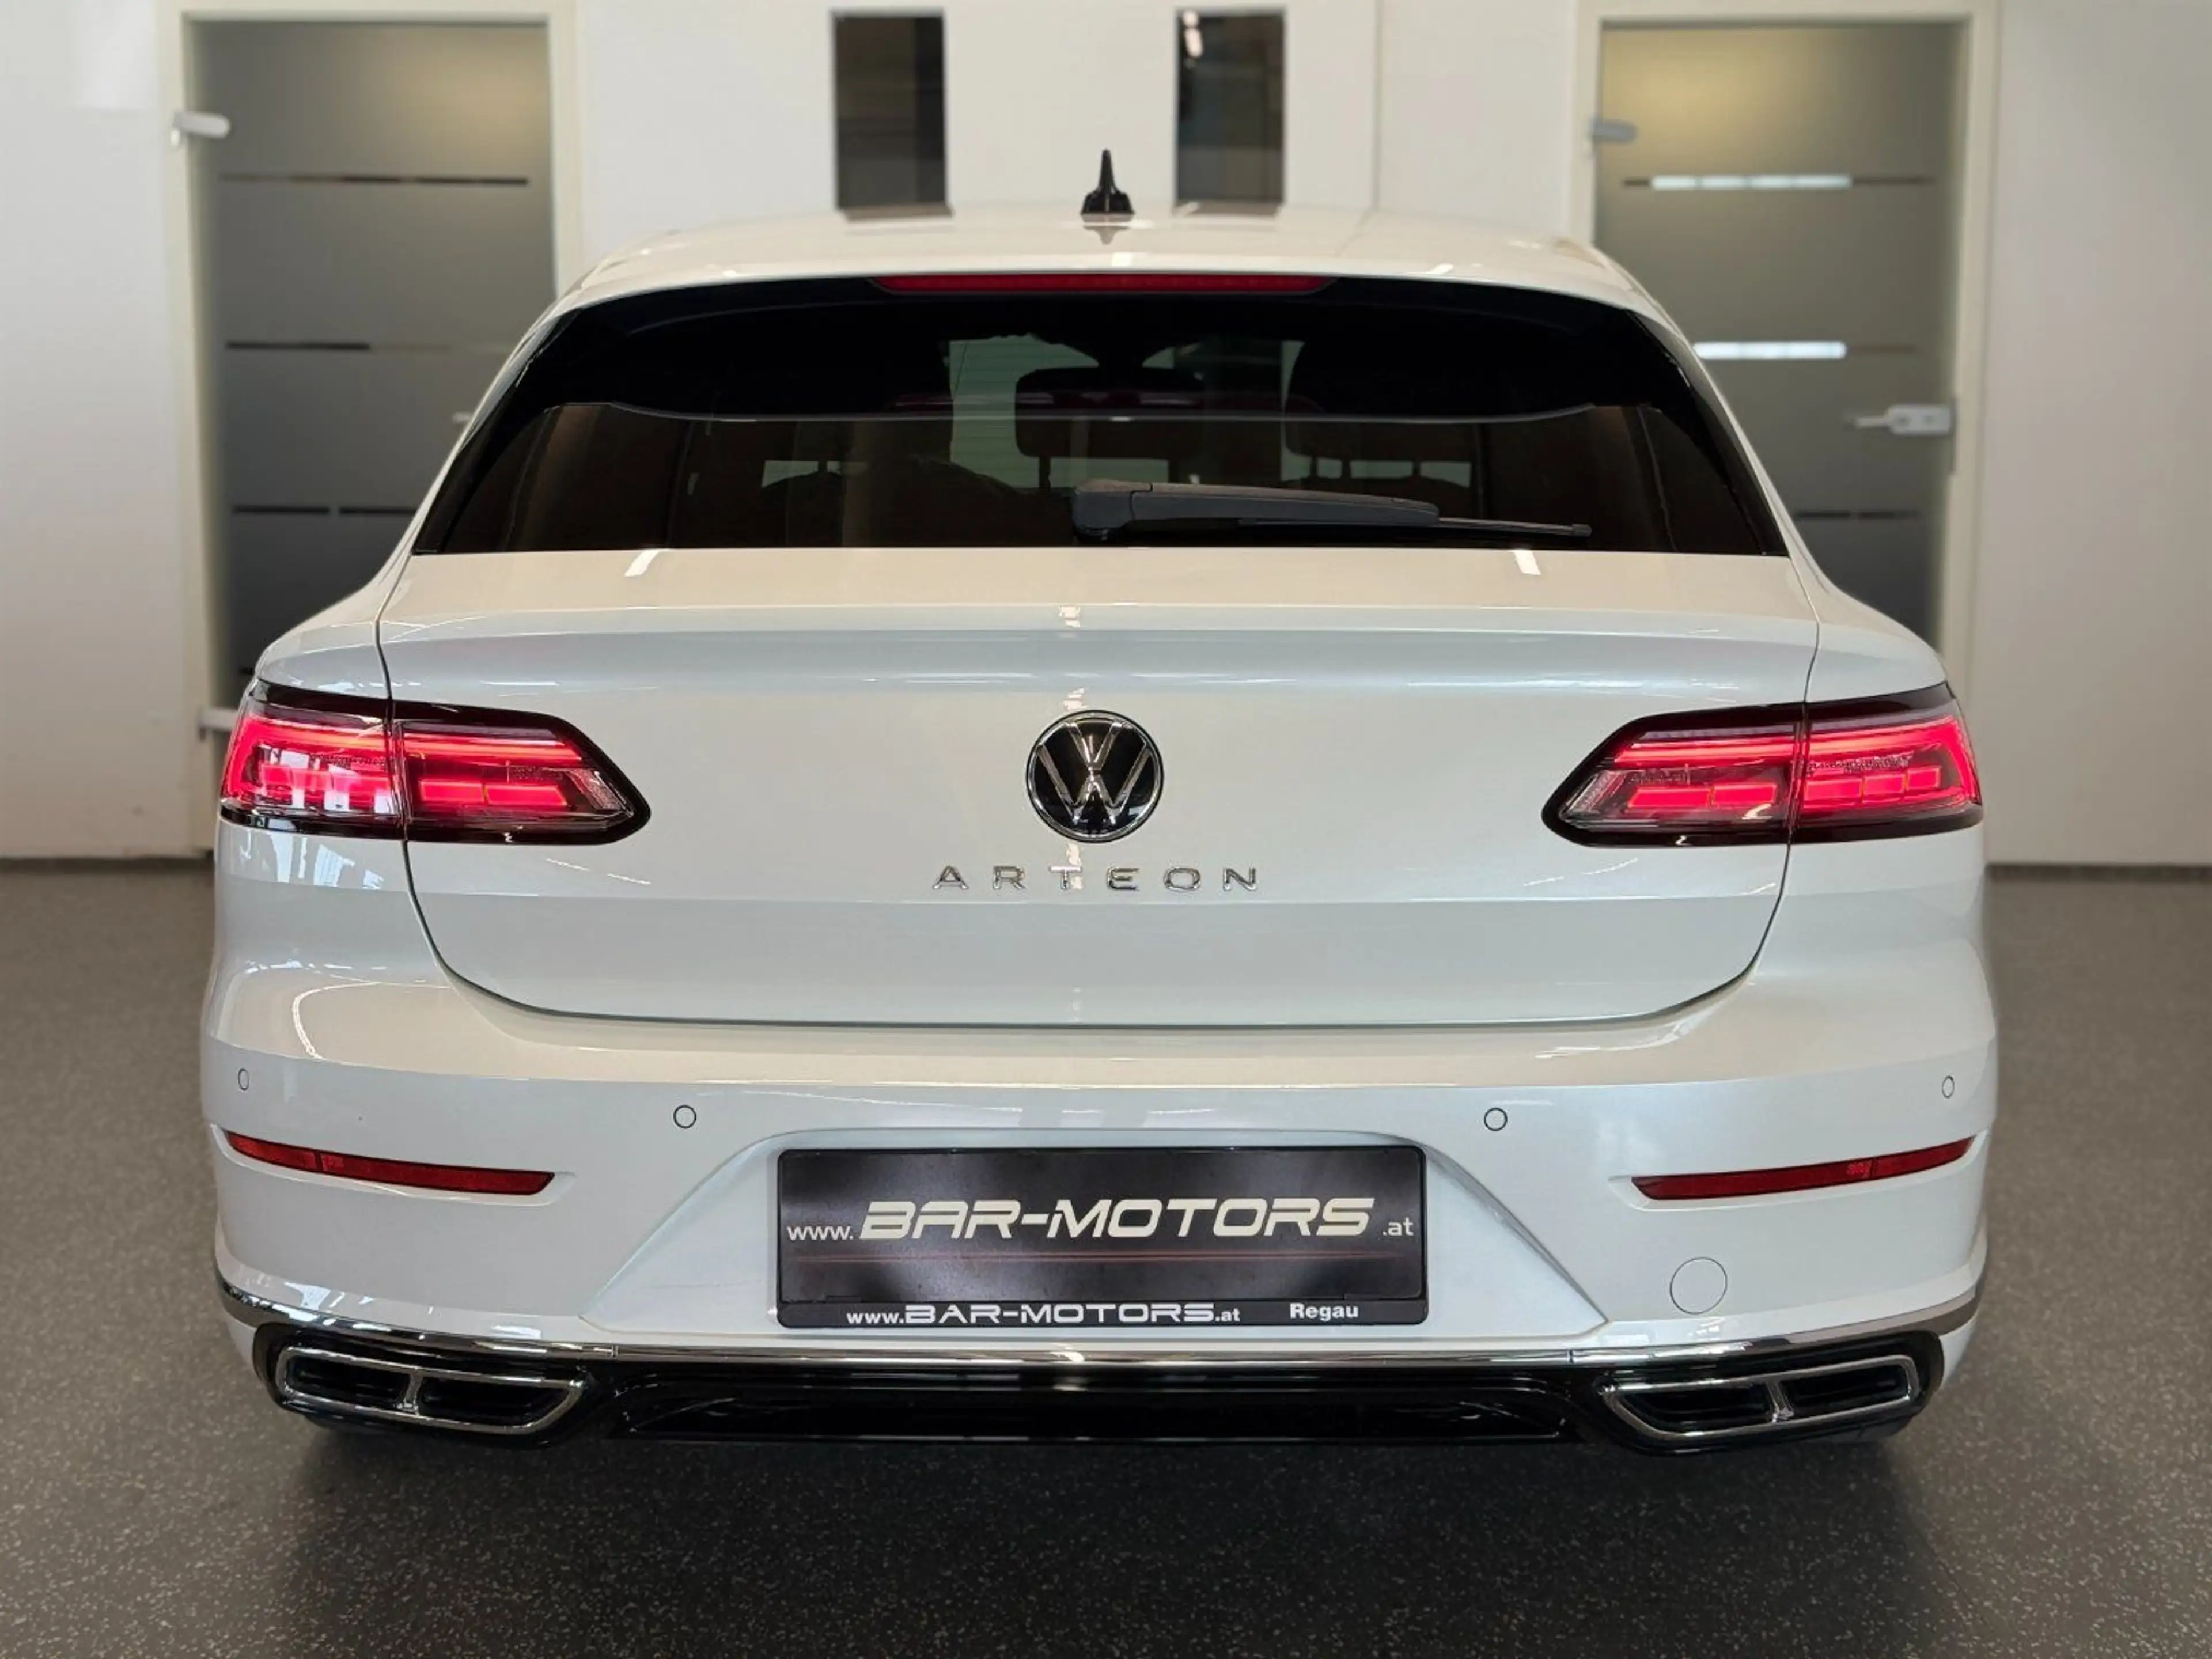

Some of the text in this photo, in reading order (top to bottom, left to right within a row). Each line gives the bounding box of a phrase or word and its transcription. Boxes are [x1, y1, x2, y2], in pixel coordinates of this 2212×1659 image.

[1036, 720, 1153, 826] VW
[933, 865, 1258, 891] ARTEON
[846, 1302, 1359, 1325] www.BAR-MOTORS.at Regau
